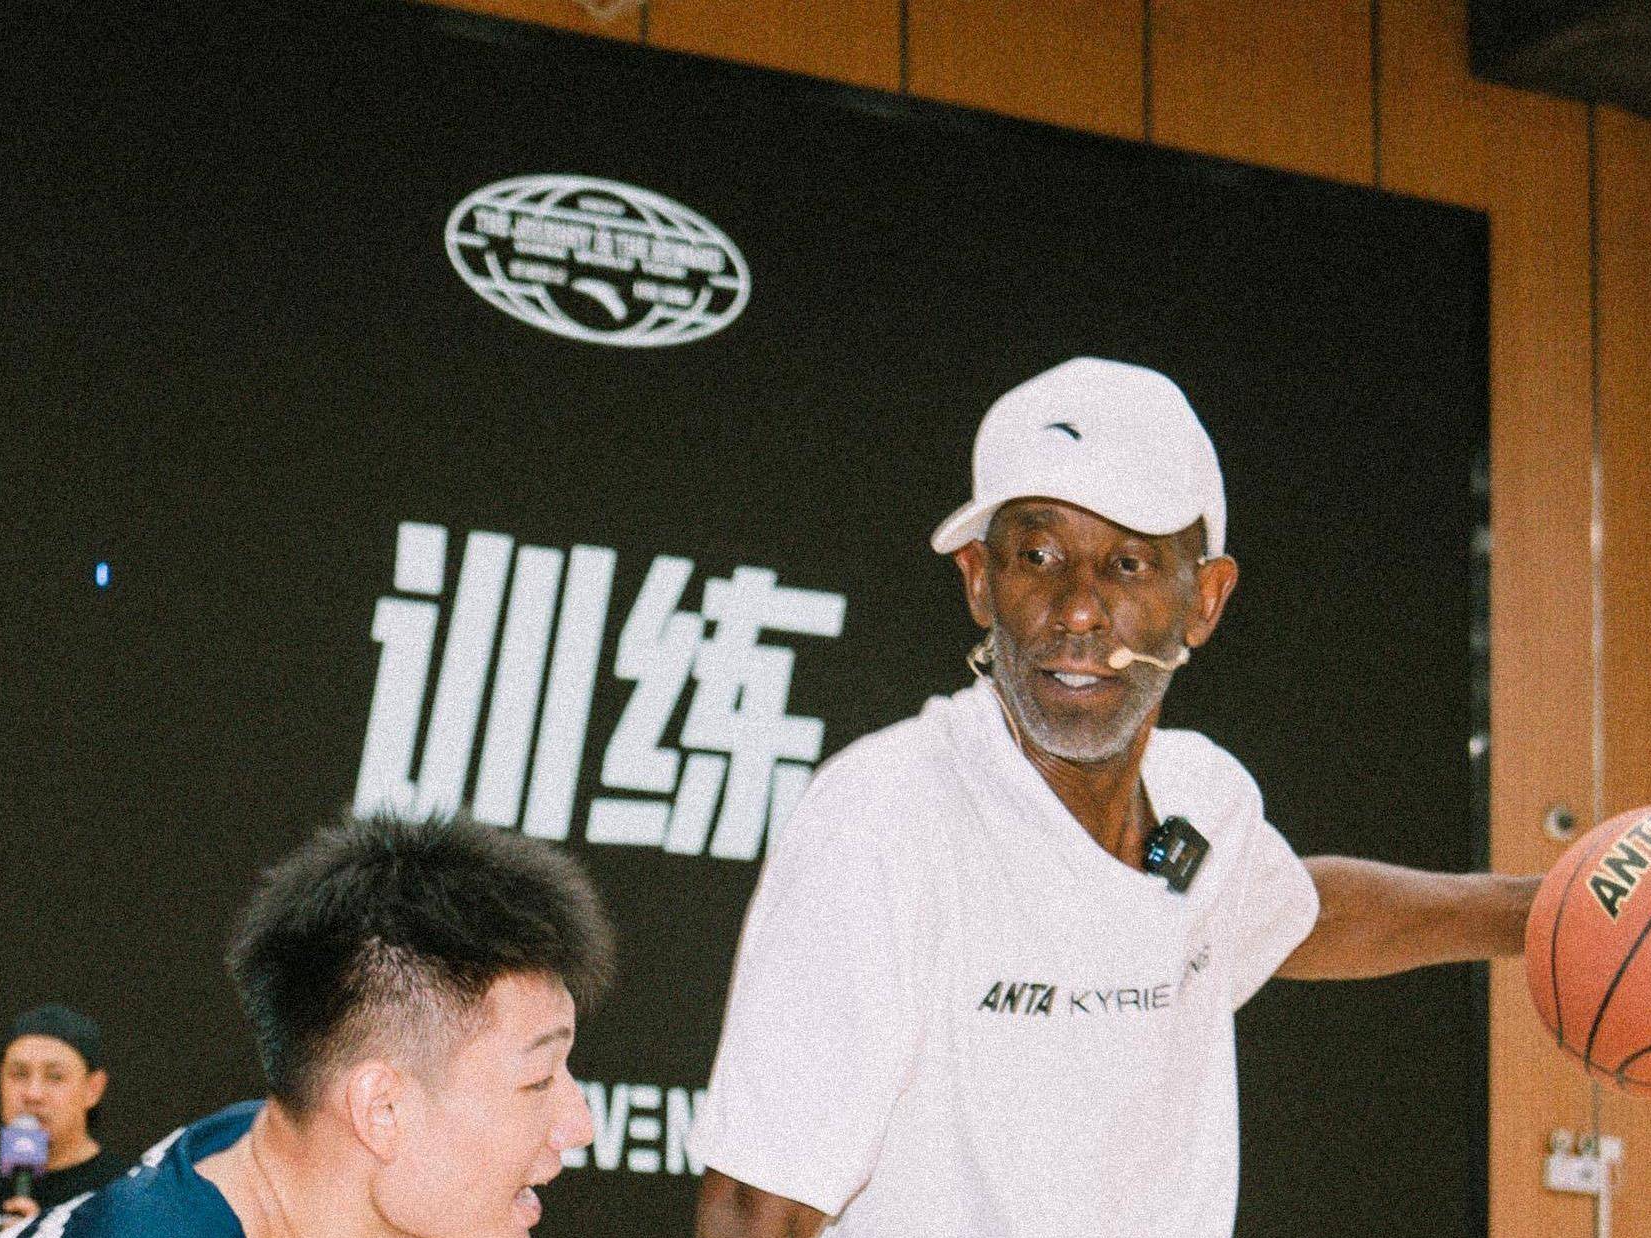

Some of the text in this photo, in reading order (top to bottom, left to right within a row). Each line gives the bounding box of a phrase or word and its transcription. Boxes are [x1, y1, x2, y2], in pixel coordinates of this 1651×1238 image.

[352, 520, 847, 862] 训练
[977, 981, 1173, 1017] ANTA KYRIE
